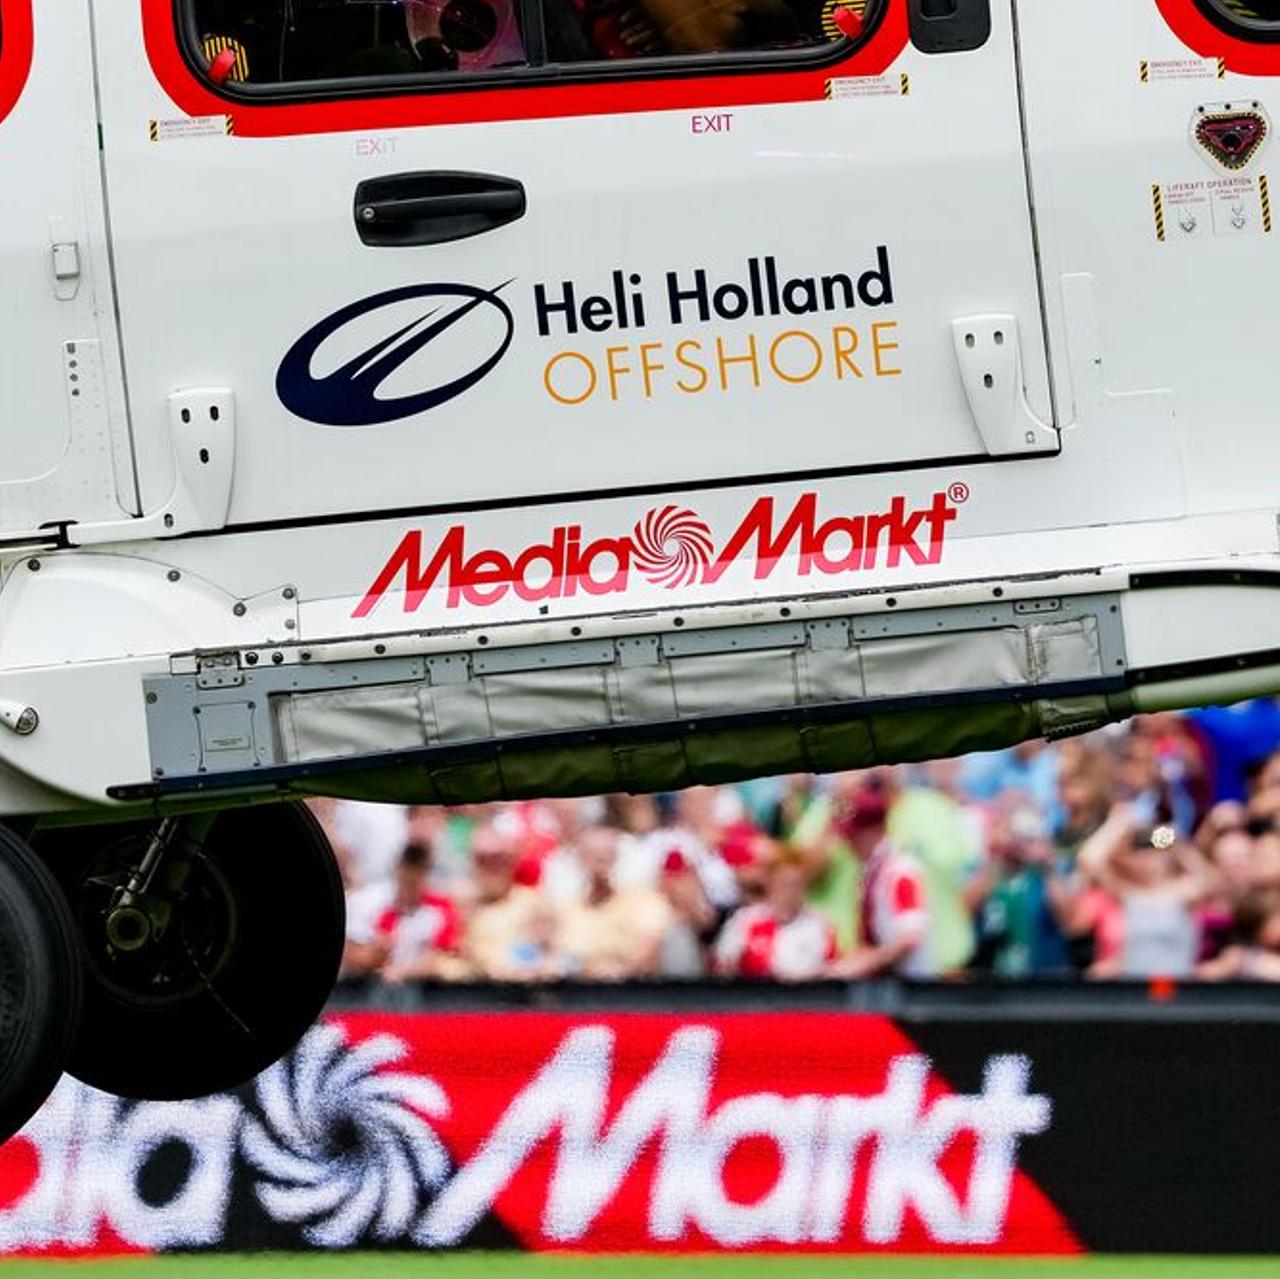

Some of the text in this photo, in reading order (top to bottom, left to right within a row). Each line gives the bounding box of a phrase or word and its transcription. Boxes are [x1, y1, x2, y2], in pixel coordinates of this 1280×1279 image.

[356, 136, 399, 156] EXIT
[692, 113, 734, 133] EXIT
[534, 245, 894, 336] Heli Holland
[542, 319, 903, 406] OFFSHORE
